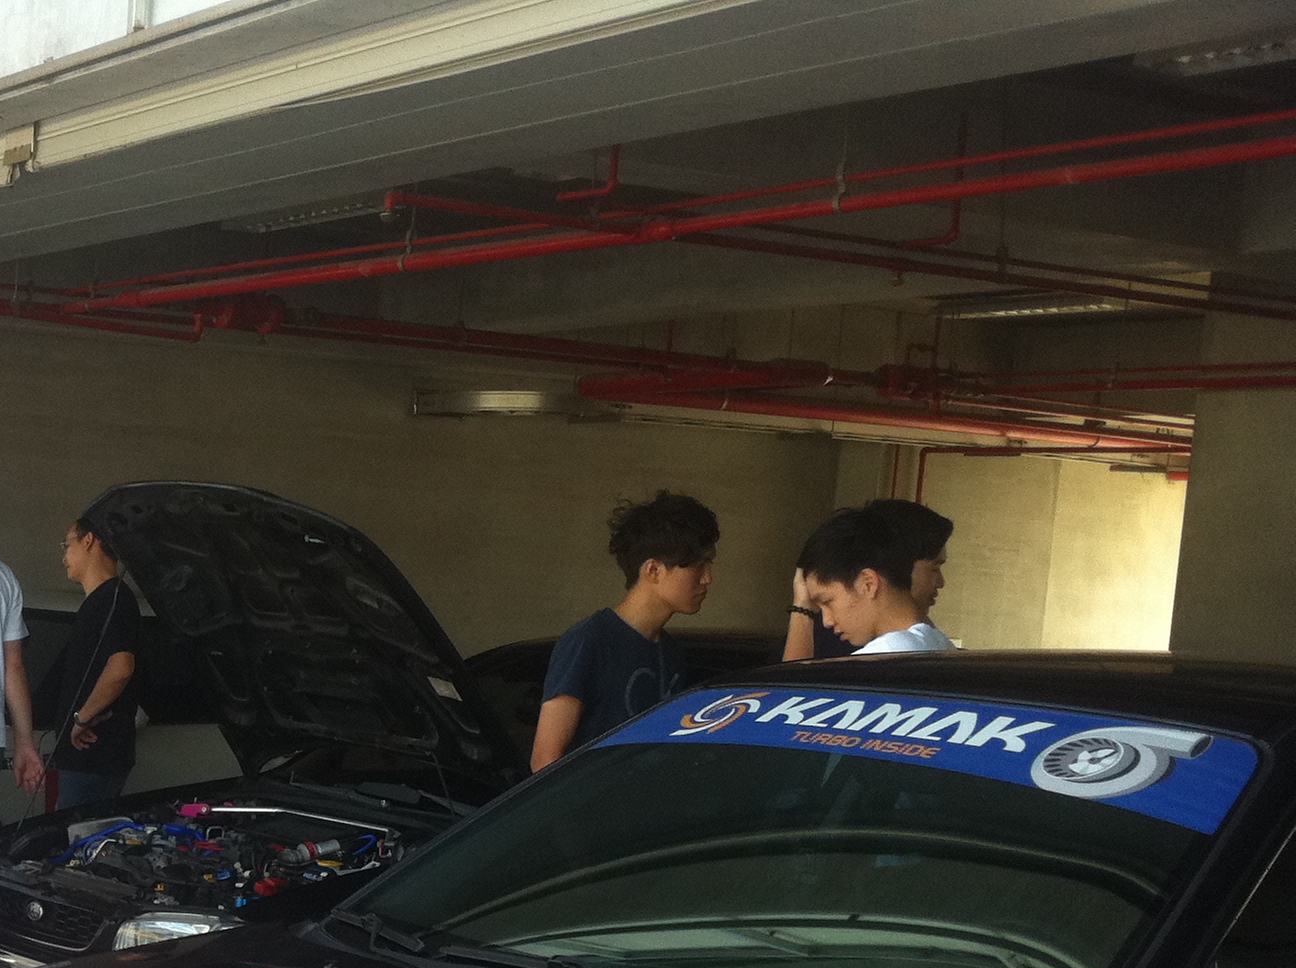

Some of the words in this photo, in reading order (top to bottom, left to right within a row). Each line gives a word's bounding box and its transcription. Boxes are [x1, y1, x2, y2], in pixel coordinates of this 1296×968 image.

[756, 696, 1054, 753] KAMAK
[790, 731, 860, 750] TURBO
[861, 739, 941, 759] INSIDE
